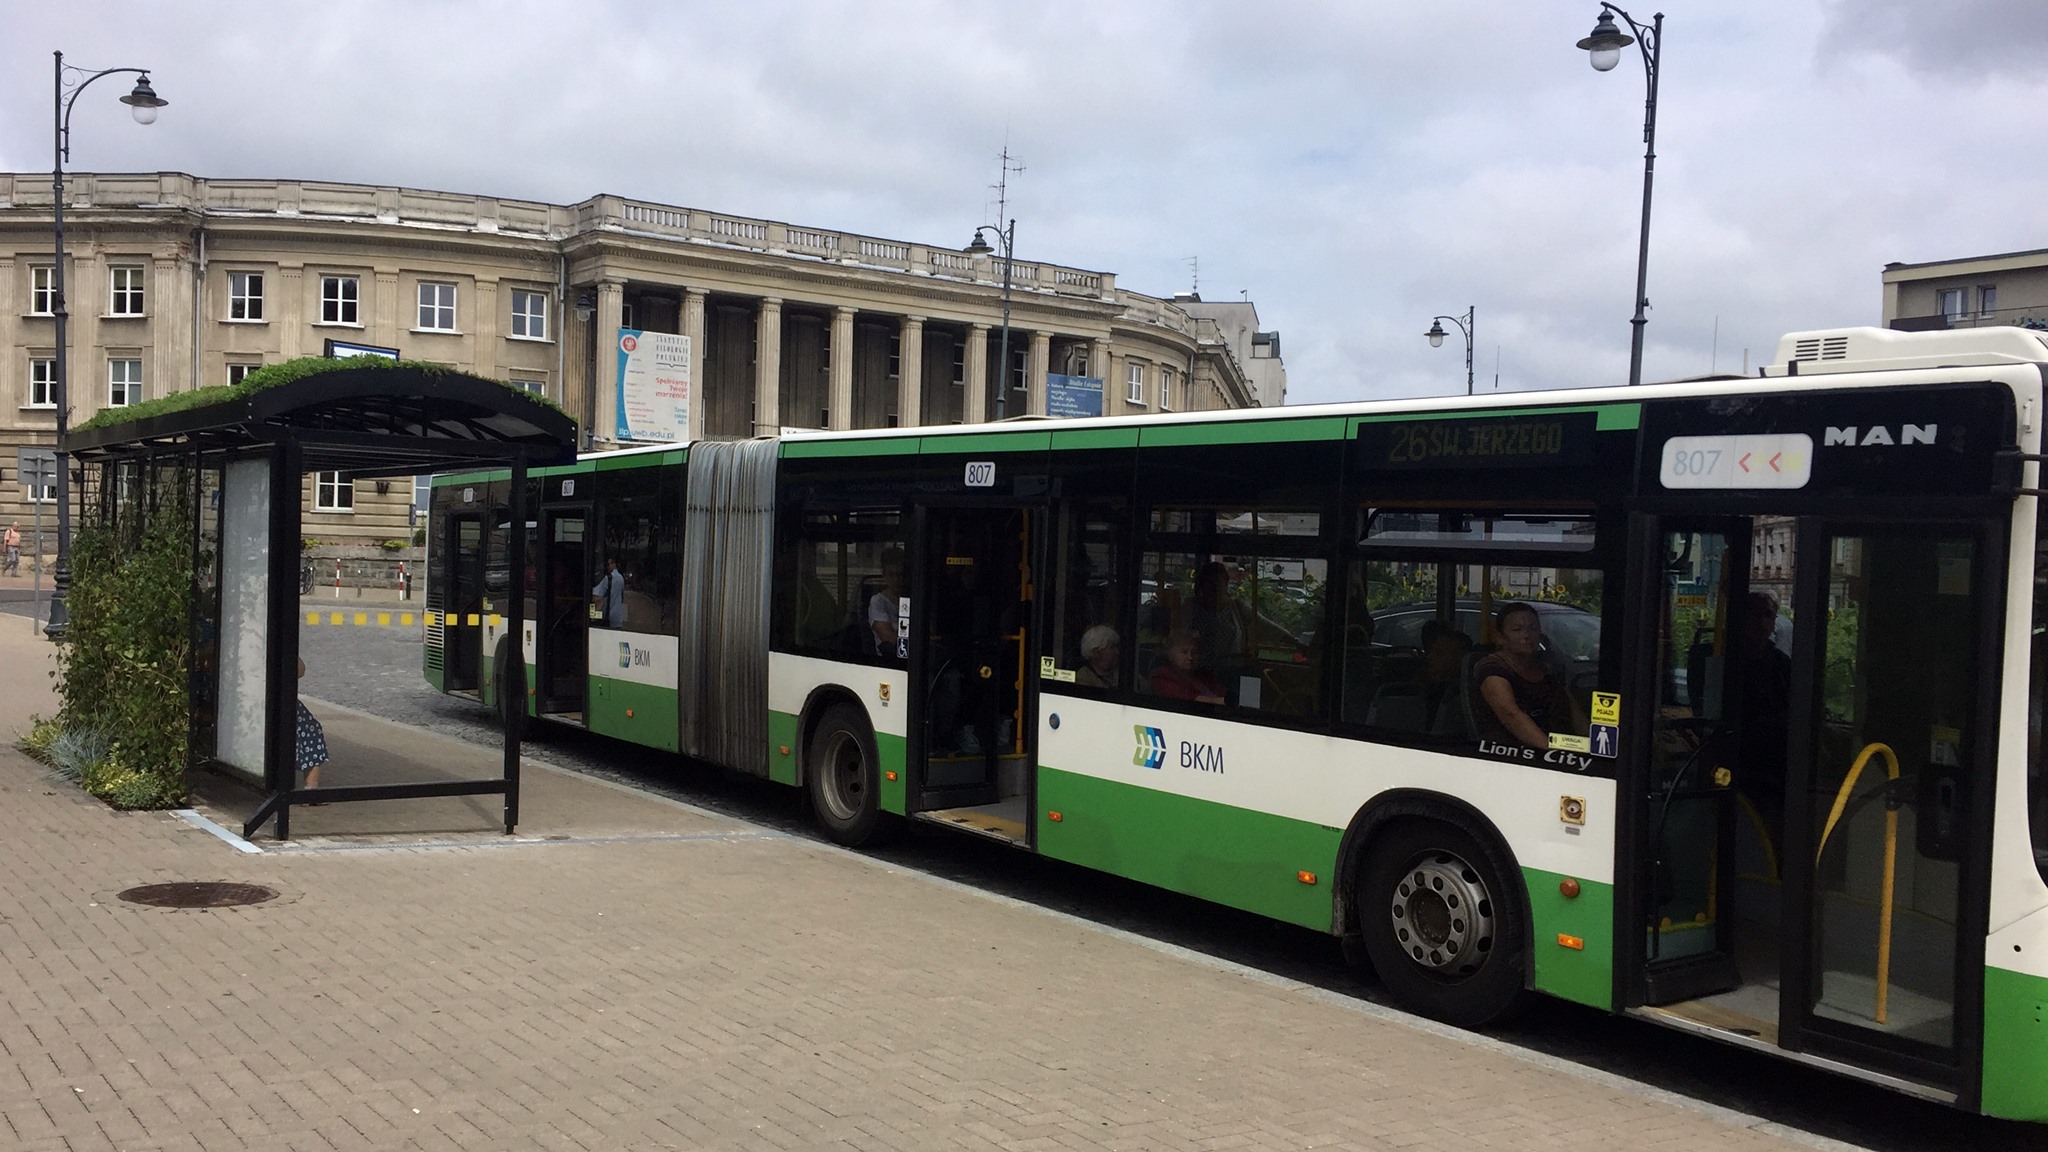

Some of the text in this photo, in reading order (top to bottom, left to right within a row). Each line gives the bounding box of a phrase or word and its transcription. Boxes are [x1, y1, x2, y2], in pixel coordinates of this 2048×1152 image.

[656, 353, 688, 363] POLSKIEJ
[1389, 424, 1429, 462] 26
[1823, 423, 1938, 447] MAN
[967, 464, 992, 484] 807
[1672, 449, 1722, 476] 807
[634, 648, 651, 668] BKM
[1180, 740, 1224, 775] BKM
[1478, 740, 1593, 771] Lion's City
